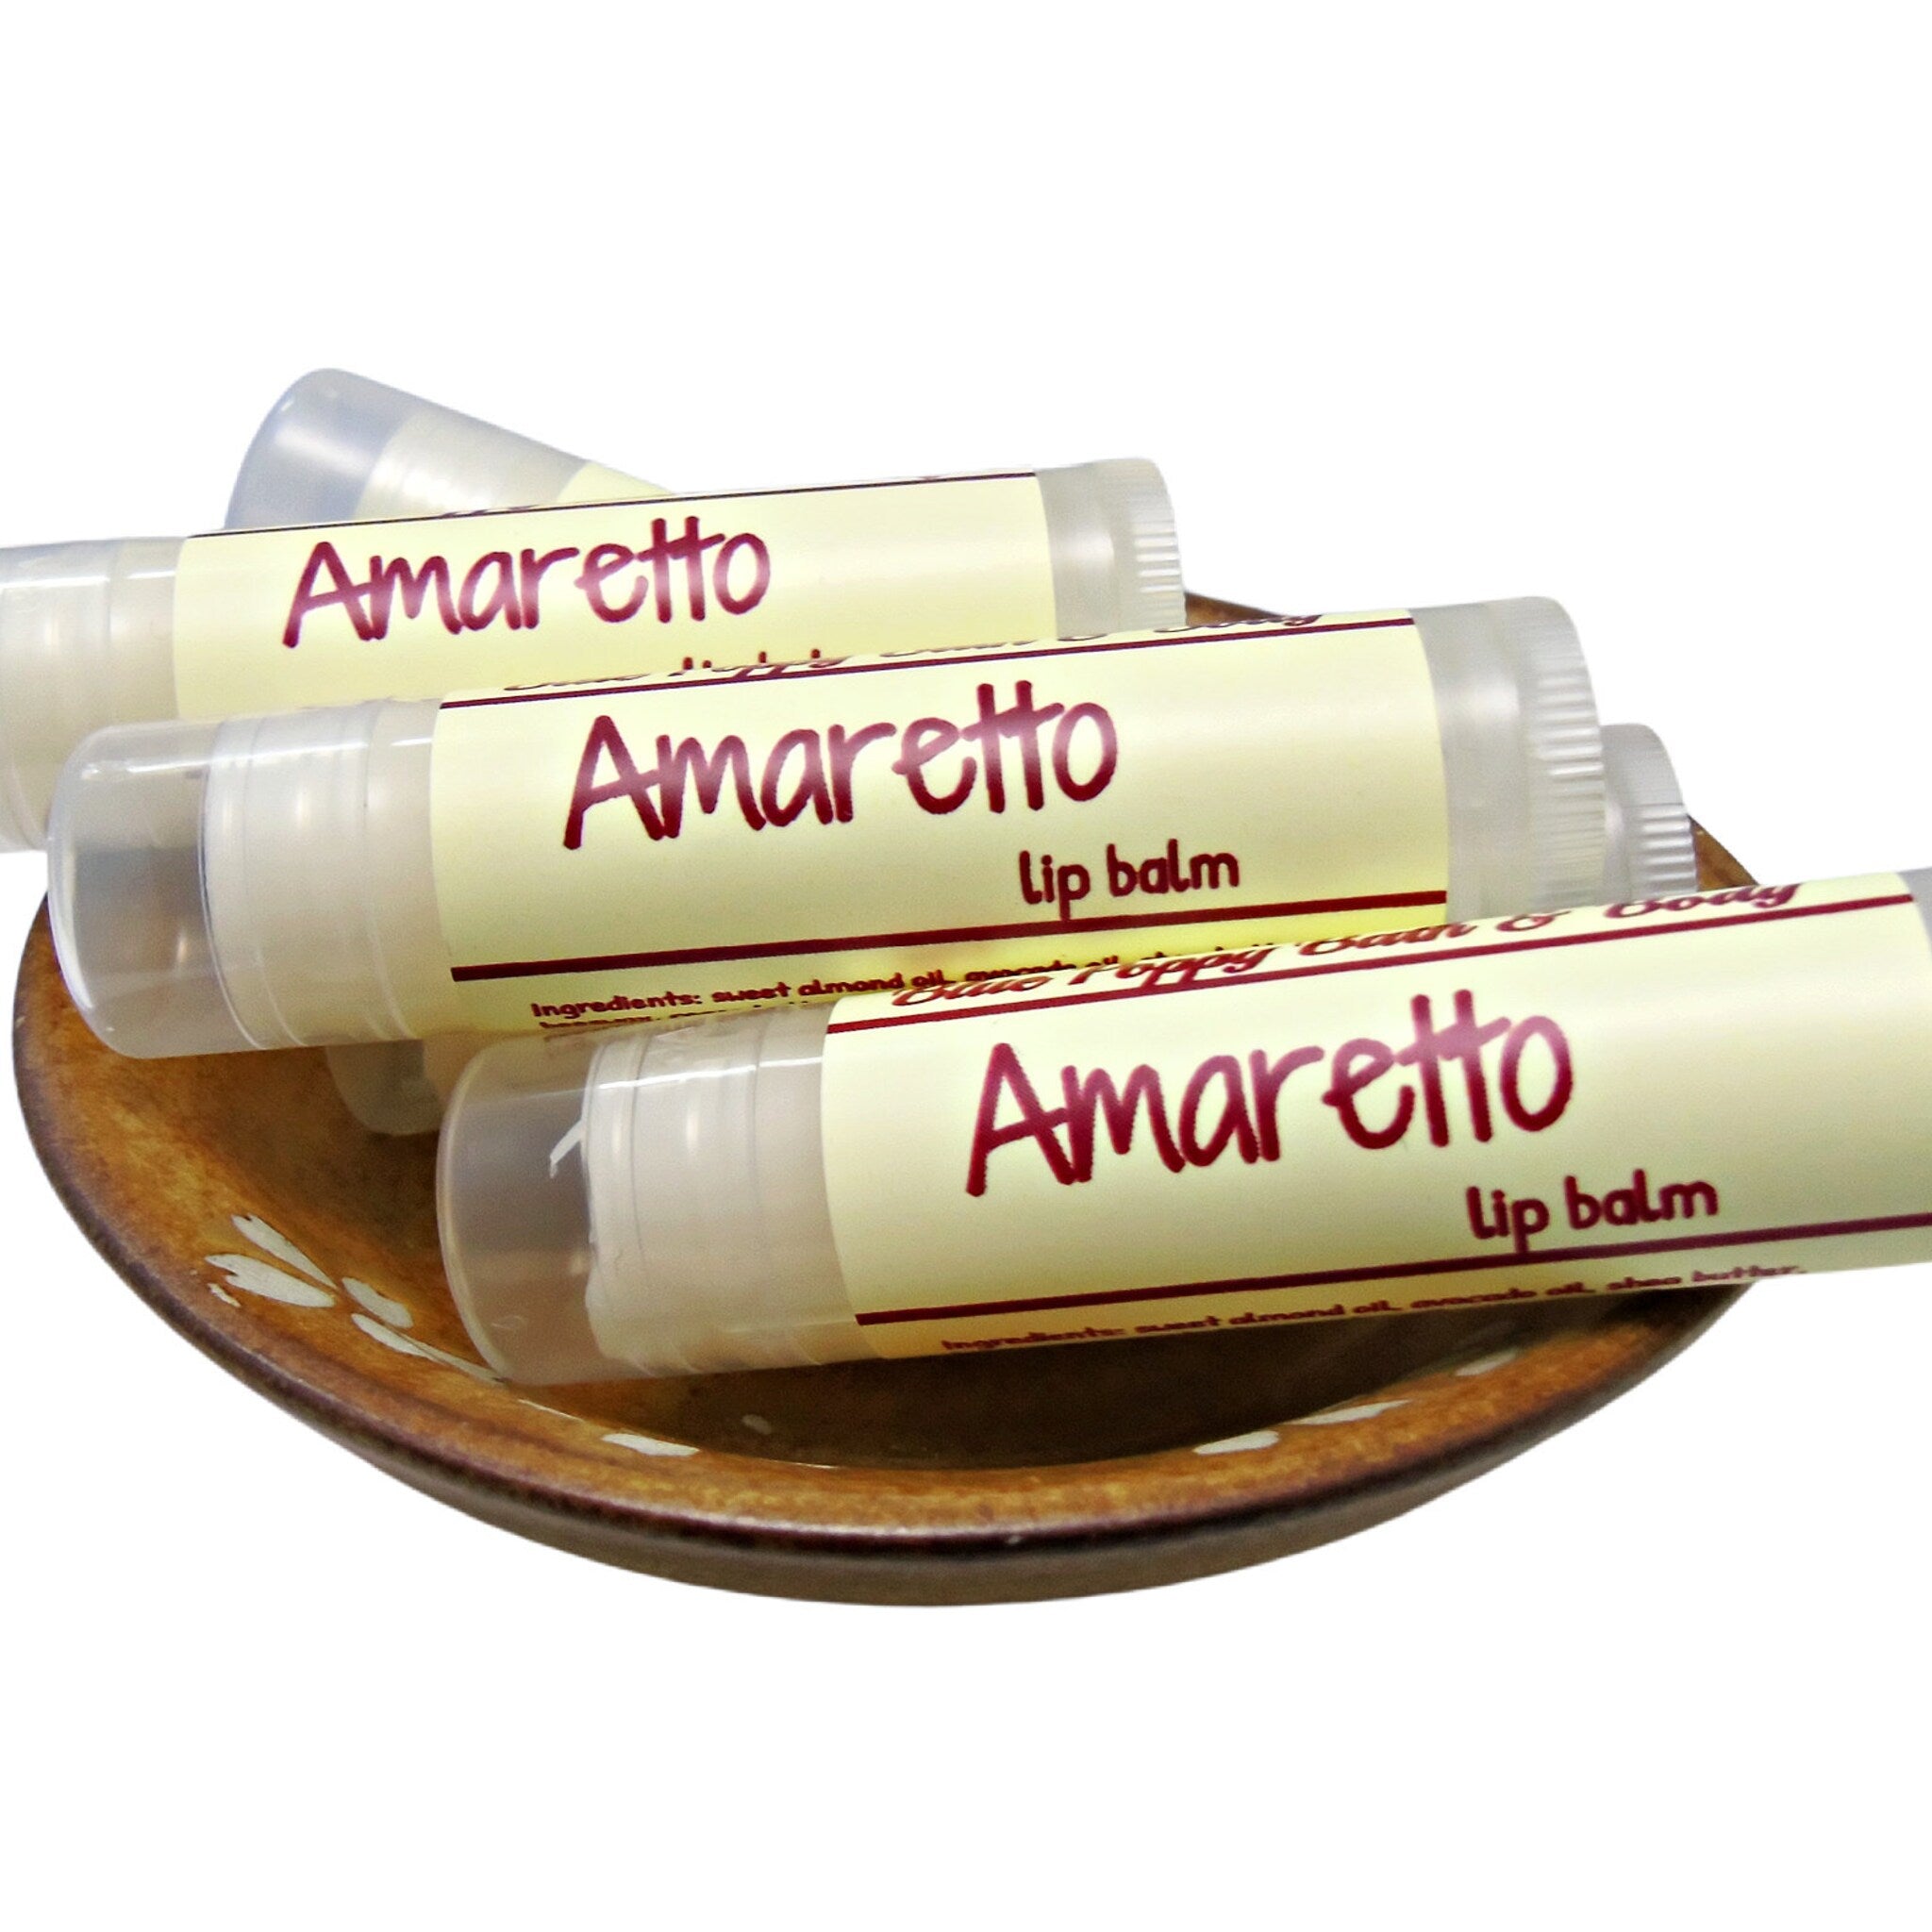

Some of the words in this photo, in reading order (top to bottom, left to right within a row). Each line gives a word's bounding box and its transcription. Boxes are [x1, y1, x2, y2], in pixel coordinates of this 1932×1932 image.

[282, 516, 770, 648] Amaretto
[563, 680, 1119, 849] Amaretto
[1019, 848, 1091, 921] lip
[1107, 839, 1241, 897] balm
[530, 991, 703, 1019] Ingredients:
[711, 982, 791, 1002] sweet
[798, 973, 905, 996] almond
[966, 989, 1574, 1197] Amaretto
[1467, 1186, 1550, 1253] lip
[1564, 1169, 1719, 1228] balm
